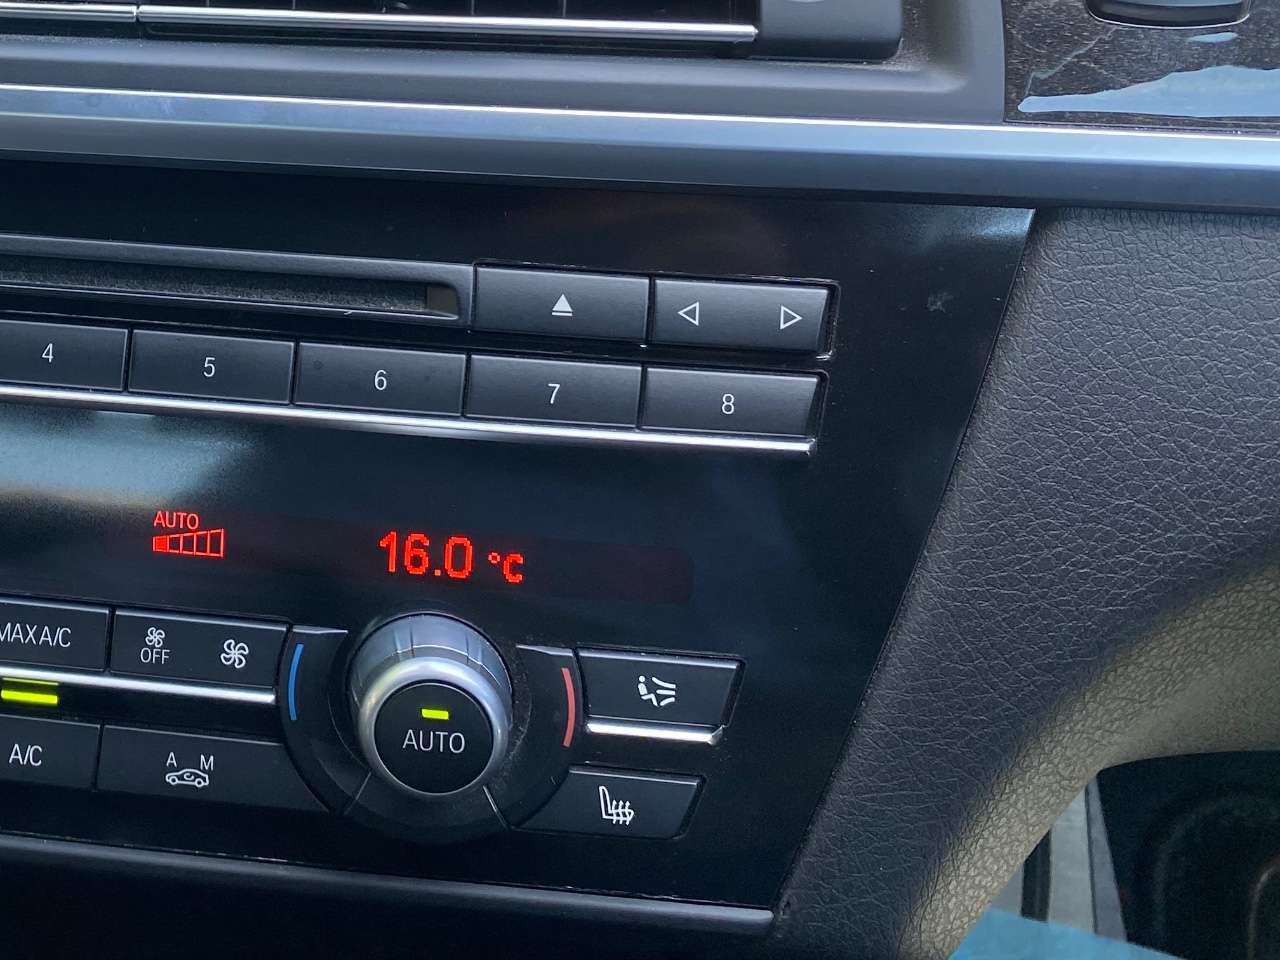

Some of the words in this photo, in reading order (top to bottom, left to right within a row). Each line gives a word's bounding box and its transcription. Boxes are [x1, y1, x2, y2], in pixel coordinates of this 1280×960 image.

[41, 343, 55, 363] 4
[202, 356, 216, 378] 5
[374, 370, 387, 391] 6
[547, 383, 561, 405] 7
[721, 394, 735, 415] 8
[153, 511, 200, 530] AUTO
[378, 531, 473, 580] 16.0
[38, 625, 72, 648] A/C
[140, 647, 171, 665] OFF
[402, 728, 466, 755] AUTO
[8, 744, 43, 768] A/C
[166, 751, 177, 768] A
[200, 754, 215, 771] M
